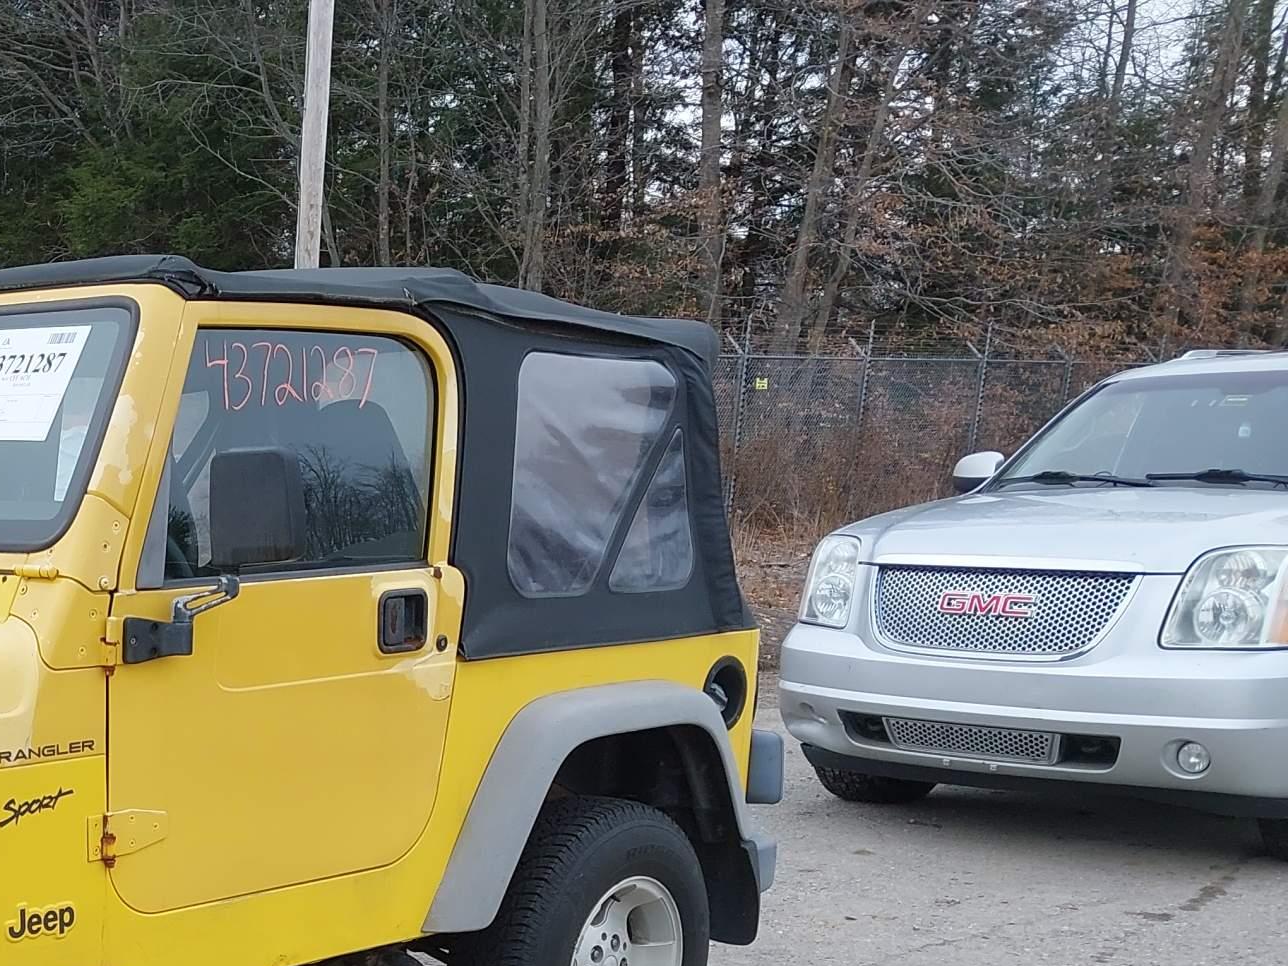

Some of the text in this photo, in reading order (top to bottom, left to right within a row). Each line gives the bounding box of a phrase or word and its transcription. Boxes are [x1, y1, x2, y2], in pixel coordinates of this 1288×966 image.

[205, 338, 378, 411] 43721287
[939, 591, 1034, 617] GMC
[8, 905, 75, 939] Jeep
